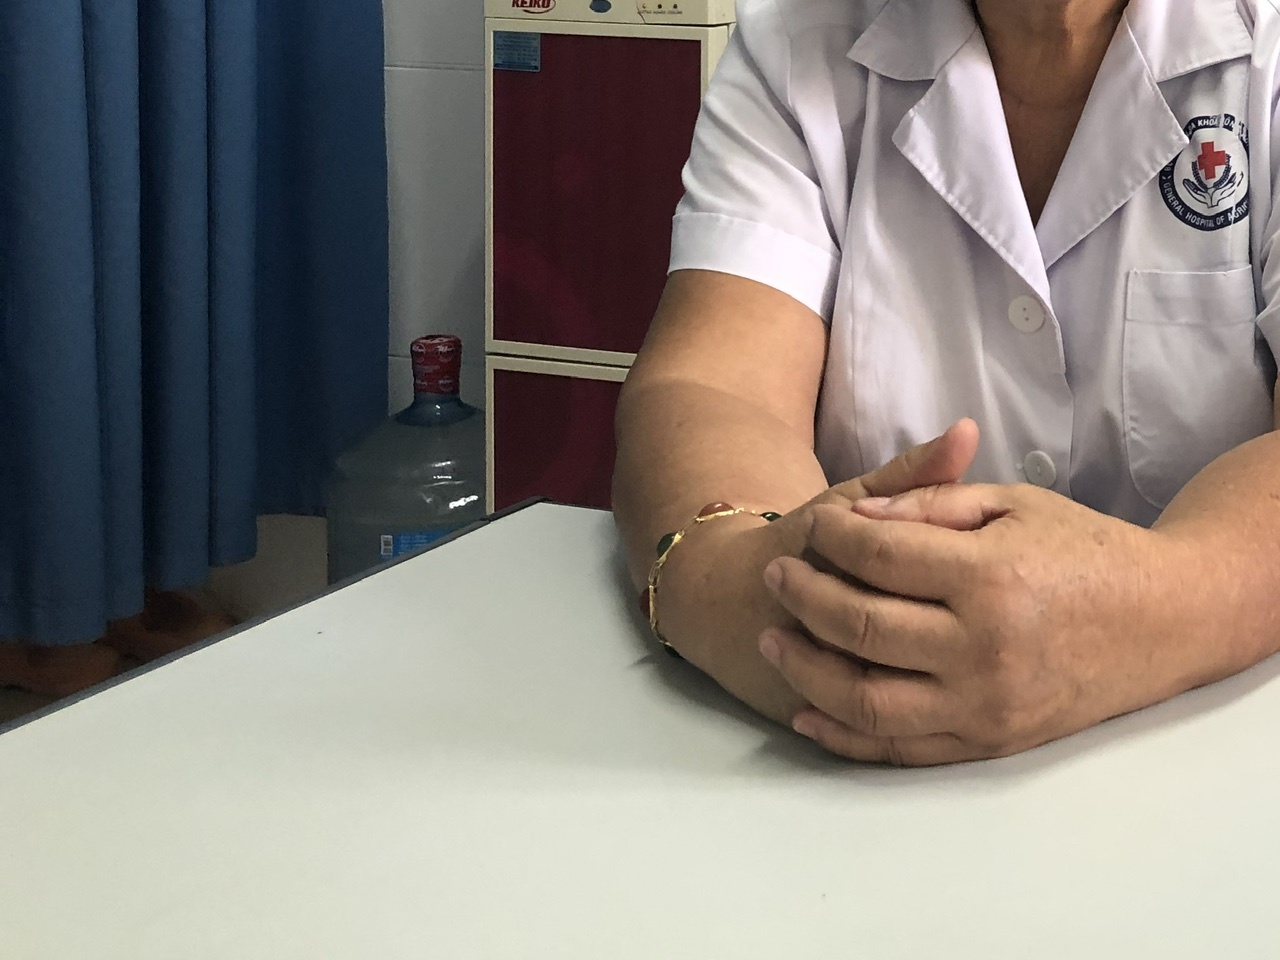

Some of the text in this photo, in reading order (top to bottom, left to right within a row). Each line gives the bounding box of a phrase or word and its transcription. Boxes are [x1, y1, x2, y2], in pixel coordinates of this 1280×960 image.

[1163, 182, 1185, 216] GENERAL
[1185, 211, 1215, 228] HOSPITAL
[1216, 215, 1225, 225] OF
